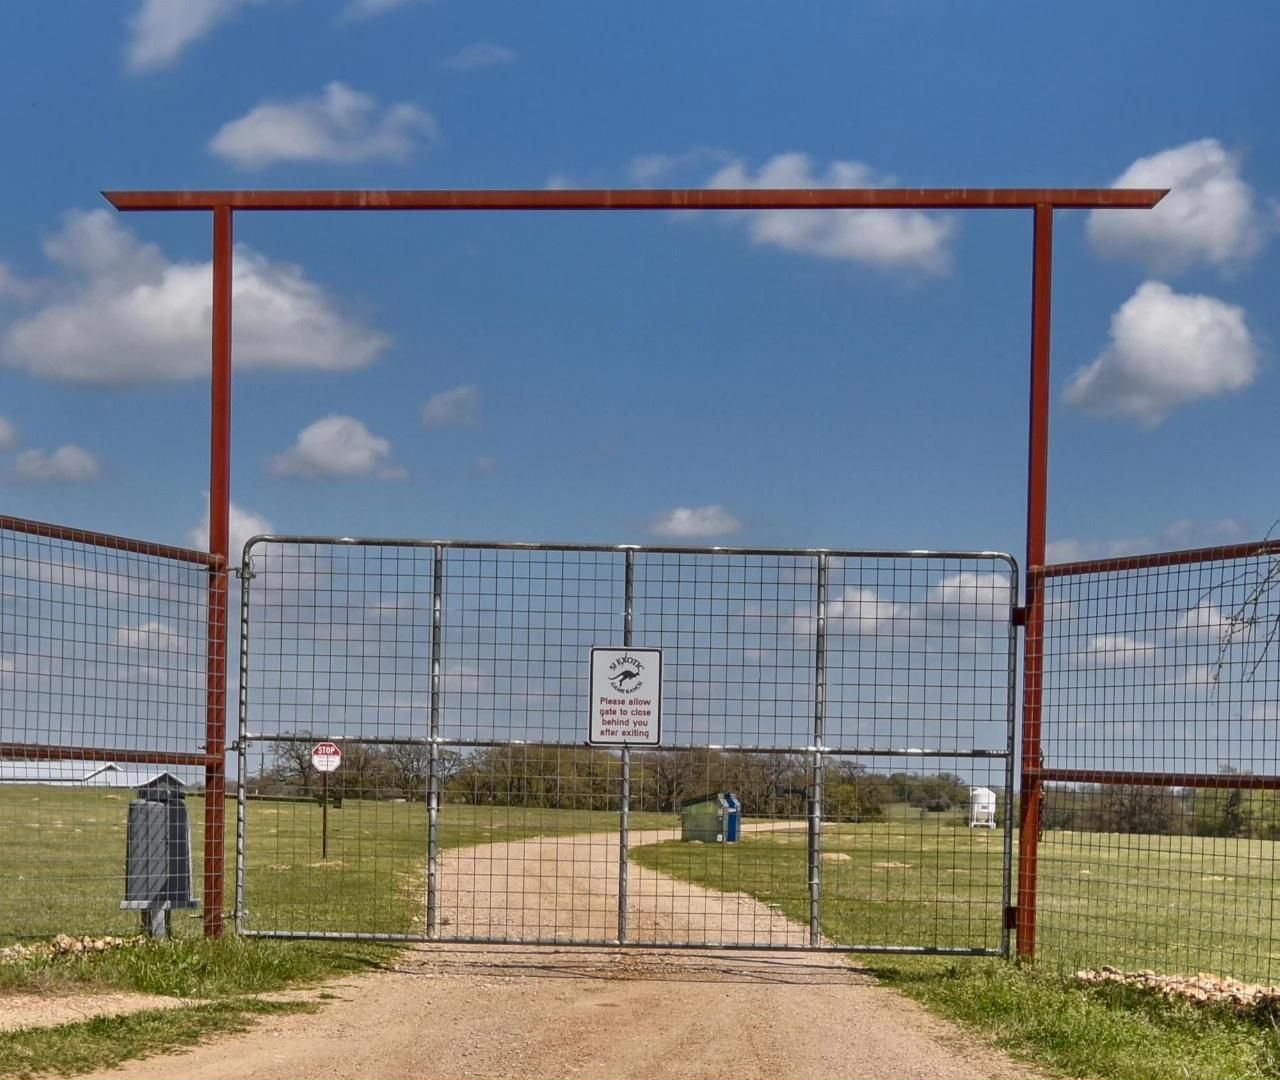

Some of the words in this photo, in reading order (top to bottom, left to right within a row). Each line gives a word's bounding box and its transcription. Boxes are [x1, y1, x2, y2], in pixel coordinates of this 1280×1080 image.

[600, 697, 626, 706] Please
[628, 697, 651, 706] allow
[599, 708, 617, 717] gate
[620, 708, 628, 716] to
[630, 708, 651, 716] close
[602, 718, 629, 726] behind
[632, 720, 648, 728] you
[600, 728, 618, 736] after
[621, 729, 649, 739] exiting
[318, 746, 336, 754] STOP
